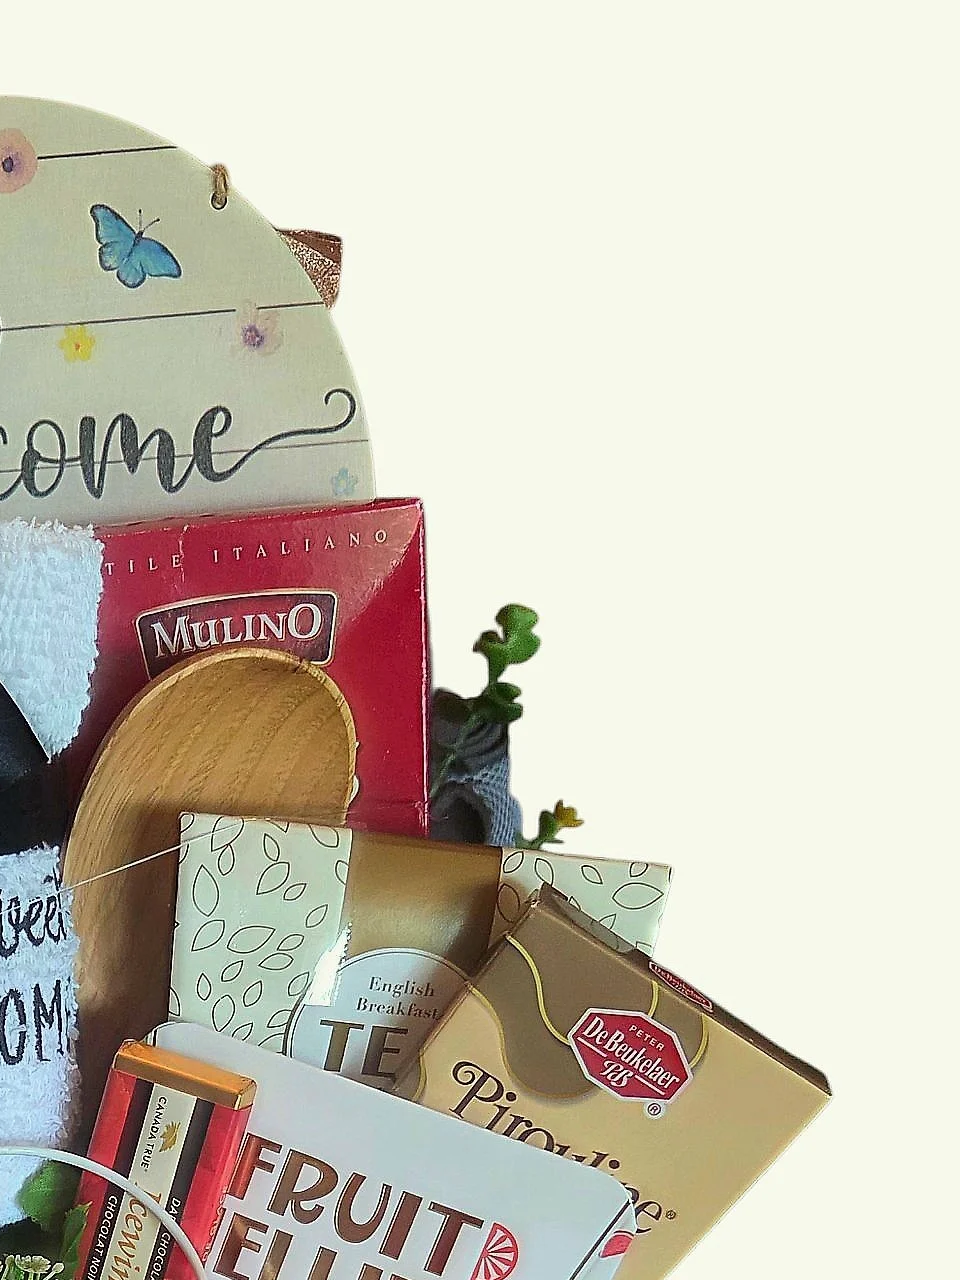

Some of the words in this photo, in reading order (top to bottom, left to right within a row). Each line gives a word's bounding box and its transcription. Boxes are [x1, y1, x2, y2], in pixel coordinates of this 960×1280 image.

[105, 554, 181, 576] TILE
[213, 530, 388, 563] ITALIANO
[150, 603, 323, 658] MULINO
[356, 997, 442, 1020] Breakfast
[369, 975, 435, 998] English
[319, 1019, 408, 1078] TE
[629, 1024, 665, 1051] PETER
[147, 1095, 168, 1143] CANADA
[140, 1142, 157, 1169] TRUE
[95, 1195, 118, 1256] CHOCOLAT
[227, 1132, 484, 1277] FRUIT
